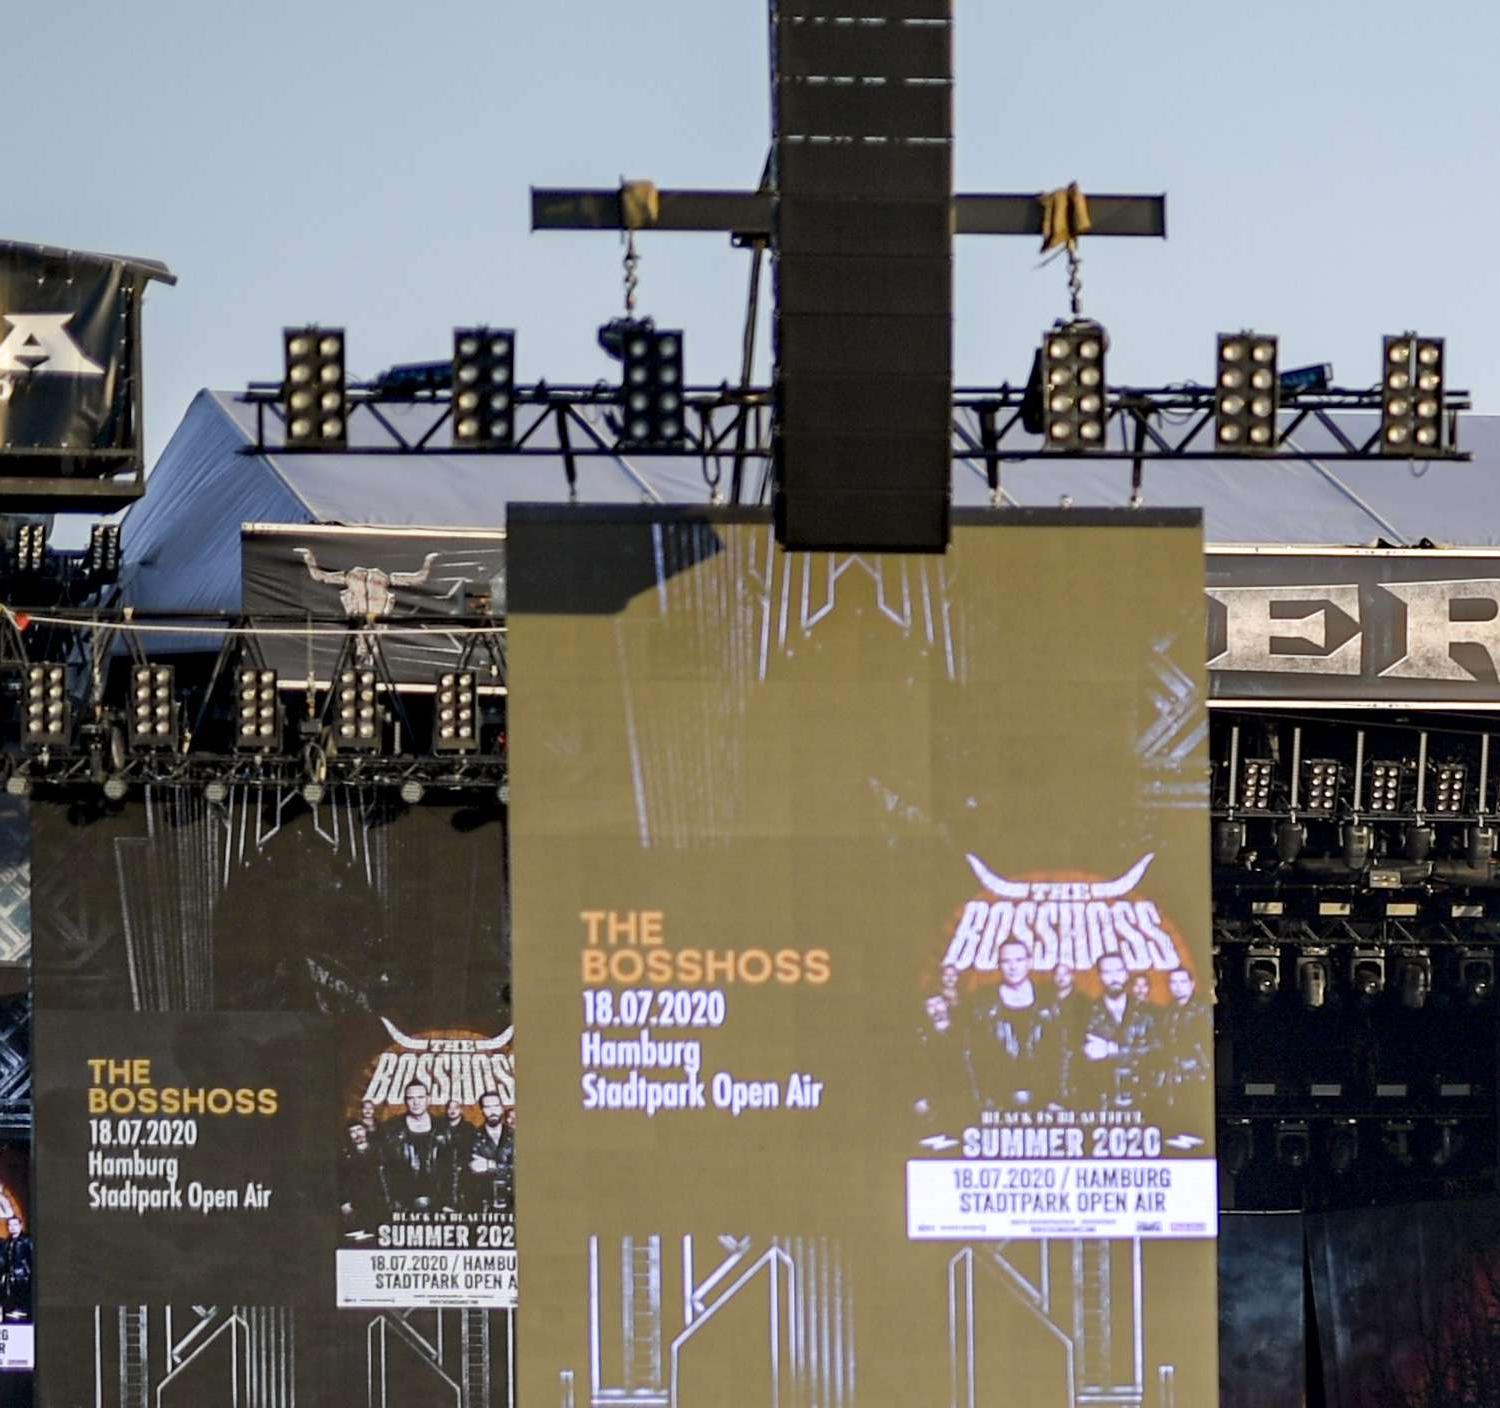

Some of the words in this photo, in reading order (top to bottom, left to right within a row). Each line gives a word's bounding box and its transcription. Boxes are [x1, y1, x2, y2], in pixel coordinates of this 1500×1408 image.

[580, 911, 664, 945] THE
[582, 949, 831, 984] BOSSHOSS
[583, 990, 726, 1026] 18.07.2020
[581, 1029, 700, 1073] Hamburg
[88, 1059, 150, 1084] THE
[364, 1053, 515, 1105] BOSSHOS
[88, 1088, 278, 1114] BOSSHOSS
[581, 1070, 705, 1116] Stadtpark
[712, 1072, 779, 1116] Open
[786, 1072, 823, 1108] Air
[89, 1120, 197, 1145] 18.07.2020
[963, 1128, 1084, 1158] SUMMER
[1092, 1127, 1161, 1157] 2020
[89, 1149, 178, 1182] Hamburg
[953, 1168, 1055, 1189] 18.07.2020
[1076, 1168, 1171, 1188] HAMBURG
[89, 1180, 182, 1215] Stadtpark
[188, 1182, 238, 1214] Open
[243, 1182, 271, 1207] Air
[960, 1193, 1070, 1213] STADTPARK
[1078, 1193, 1127, 1212] OPEN
[1134, 1193, 1166, 1212] AIR
[378, 1226, 469, 1247] SUMMER
[476, 1225, 515, 1247] 202
[370, 1256, 448, 1271] 18.07.2020
[464, 1256, 516, 1271] HAMBU
[376, 1274, 459, 1289] STADTPARK
[465, 1274, 496, 1288] OPEN
